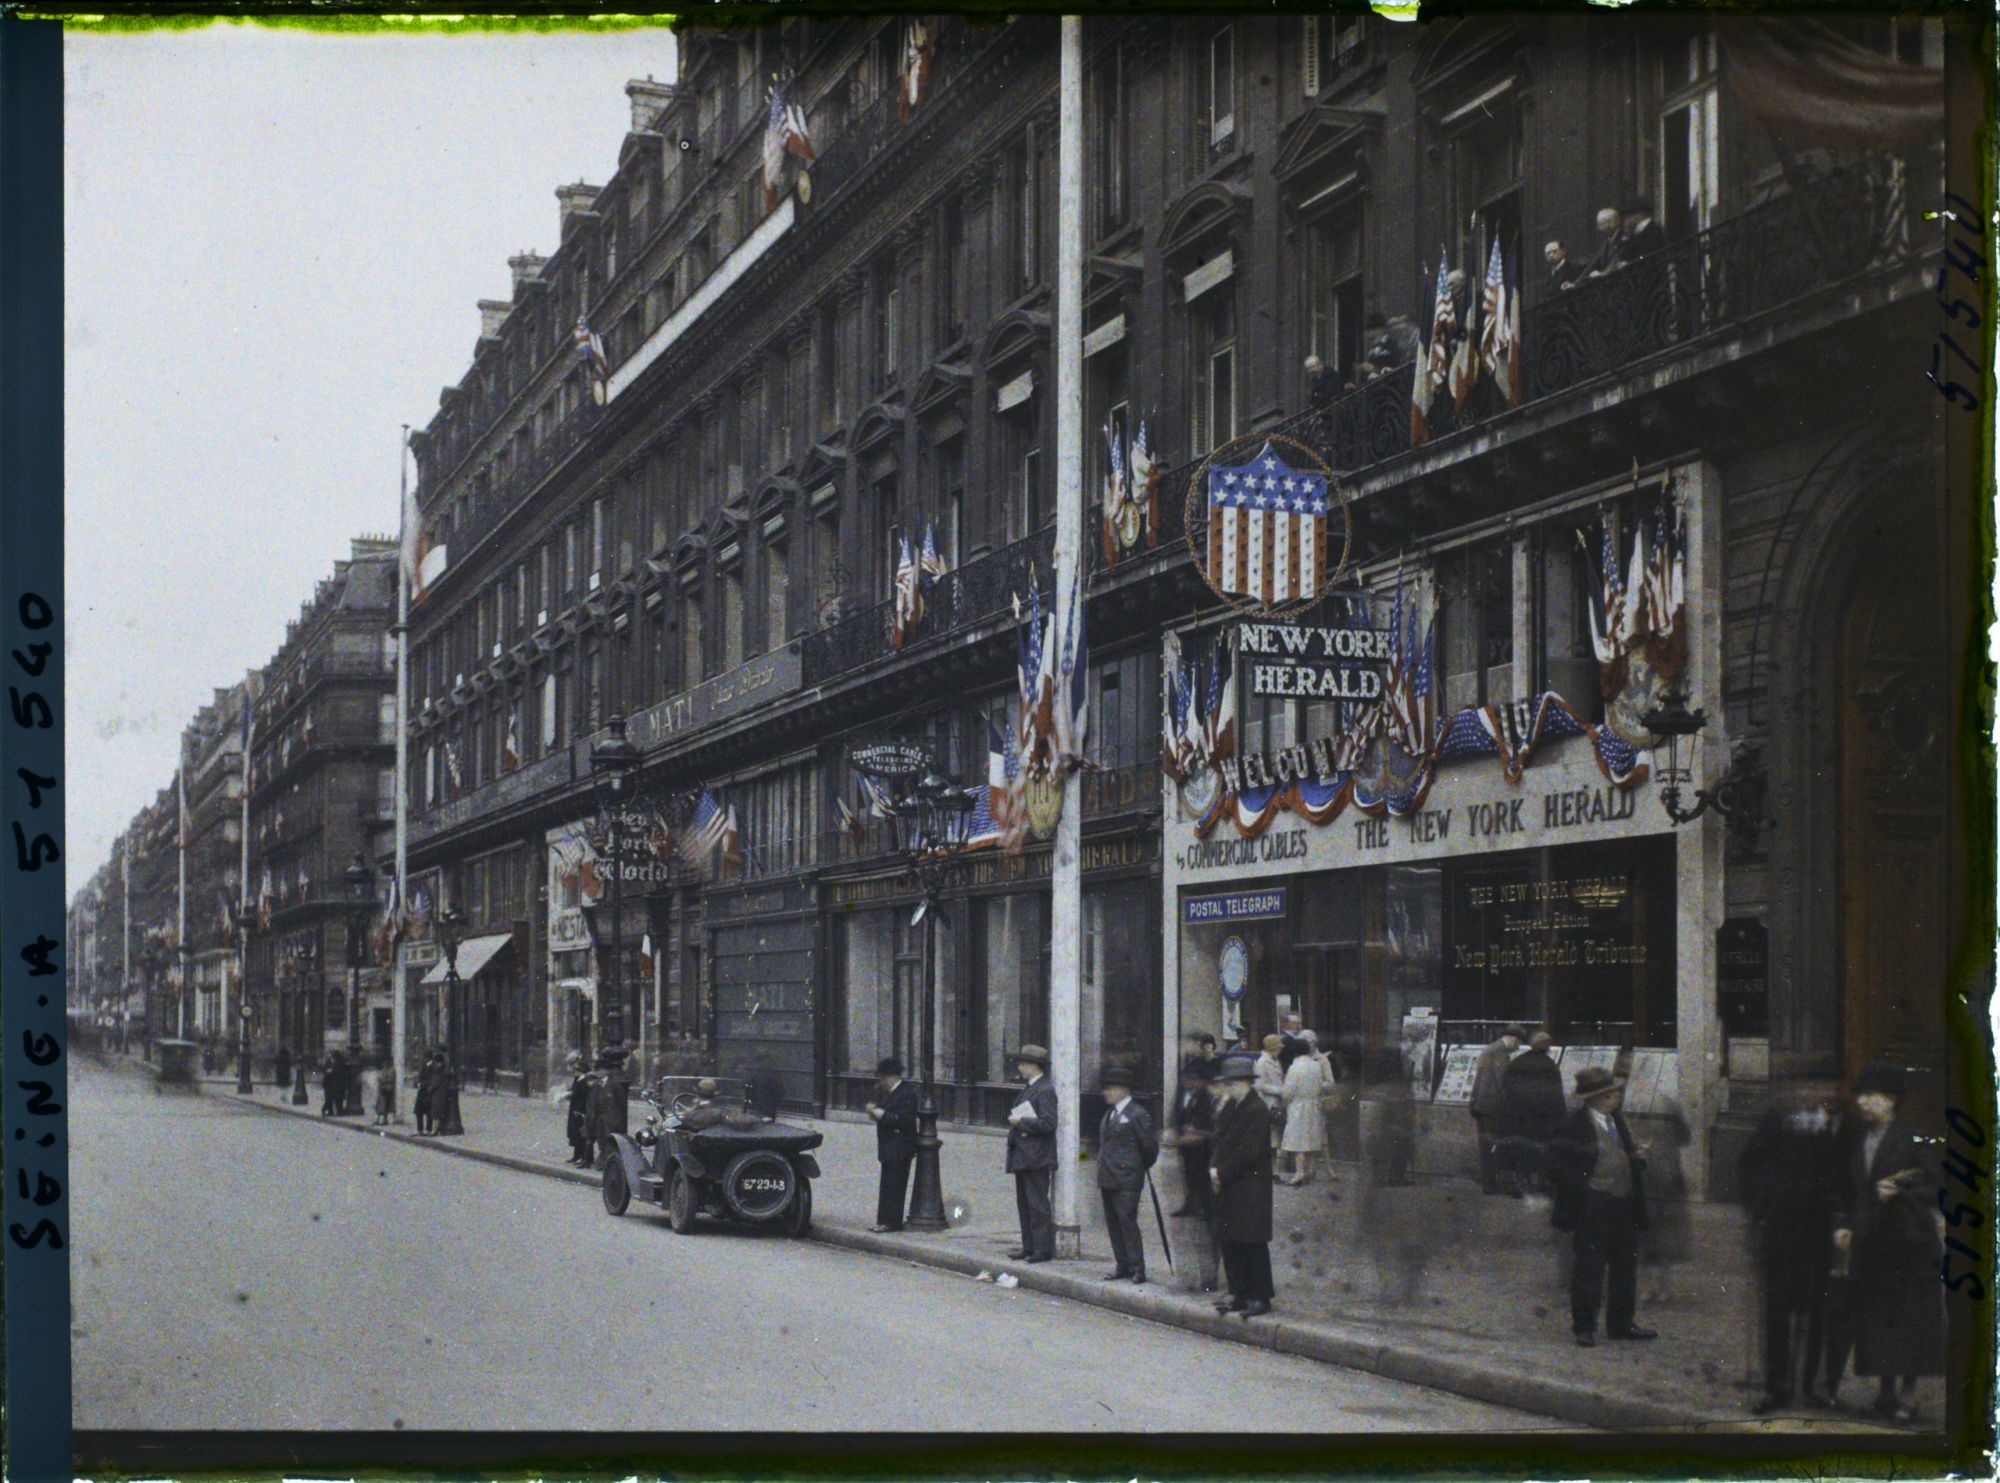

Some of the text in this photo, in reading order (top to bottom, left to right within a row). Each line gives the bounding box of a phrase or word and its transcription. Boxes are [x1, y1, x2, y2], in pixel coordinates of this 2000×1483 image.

[1925, 190, 1985, 412] 51540
[1238, 622, 1392, 659] NEW YORK
[1253, 665, 1381, 699] HERALD
[852, 745, 897, 761] COMMERCIAL
[900, 746, 923, 762] CABLE
[867, 764, 917, 773] AMERICA
[1354, 787, 1636, 850] THE NEW YORK HERALD
[1187, 838, 1257, 870] COMMERCIAL
[1260, 829, 1308, 862] CABLES
[1189, 895, 1281, 918] POSTAL TELEGRAPH
[1470, 886, 1493, 905] THE
[1499, 883, 1528, 904] NEW
[1532, 880, 1569, 900] YORK
[1454, 938, 1648, 976] New York Herald Tribune
[1937, 1106, 1988, 1302] 51540
